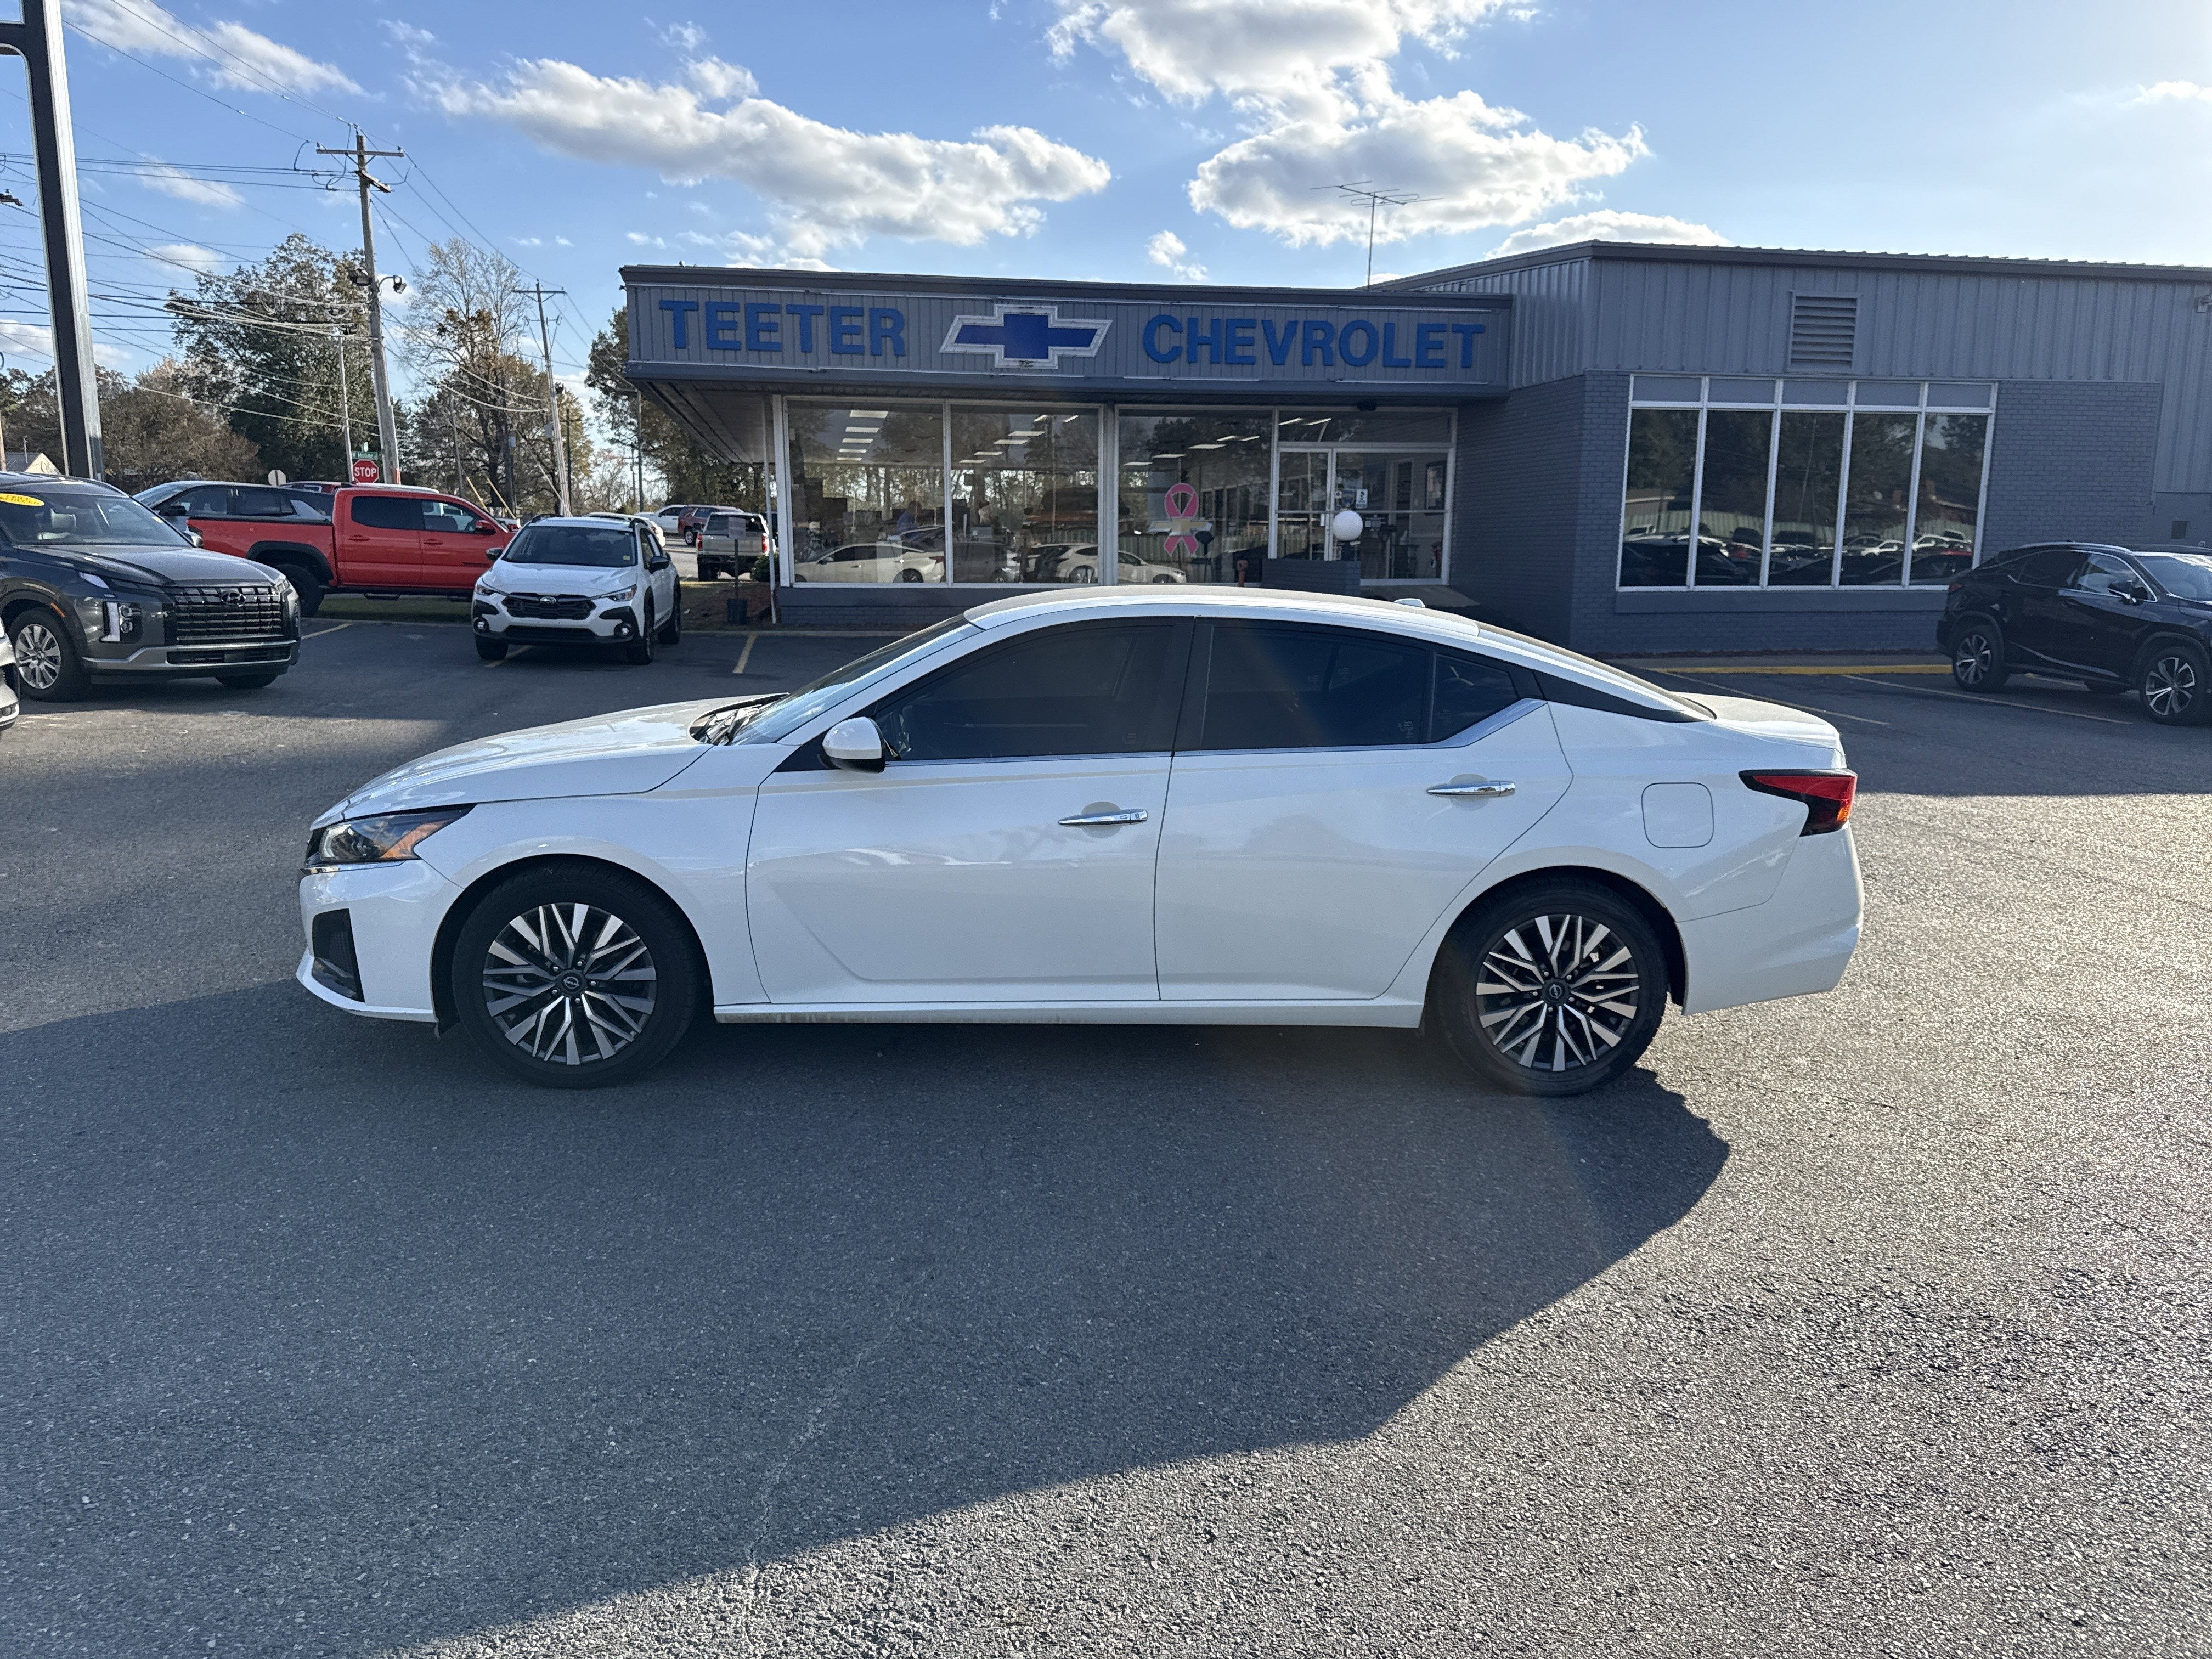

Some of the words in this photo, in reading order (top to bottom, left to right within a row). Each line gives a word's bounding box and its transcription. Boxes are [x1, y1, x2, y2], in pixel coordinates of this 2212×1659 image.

[659, 300, 905, 356] TEETER
[1143, 314, 1485, 368] CHEVROLET
[354, 467, 377, 477] STOP
